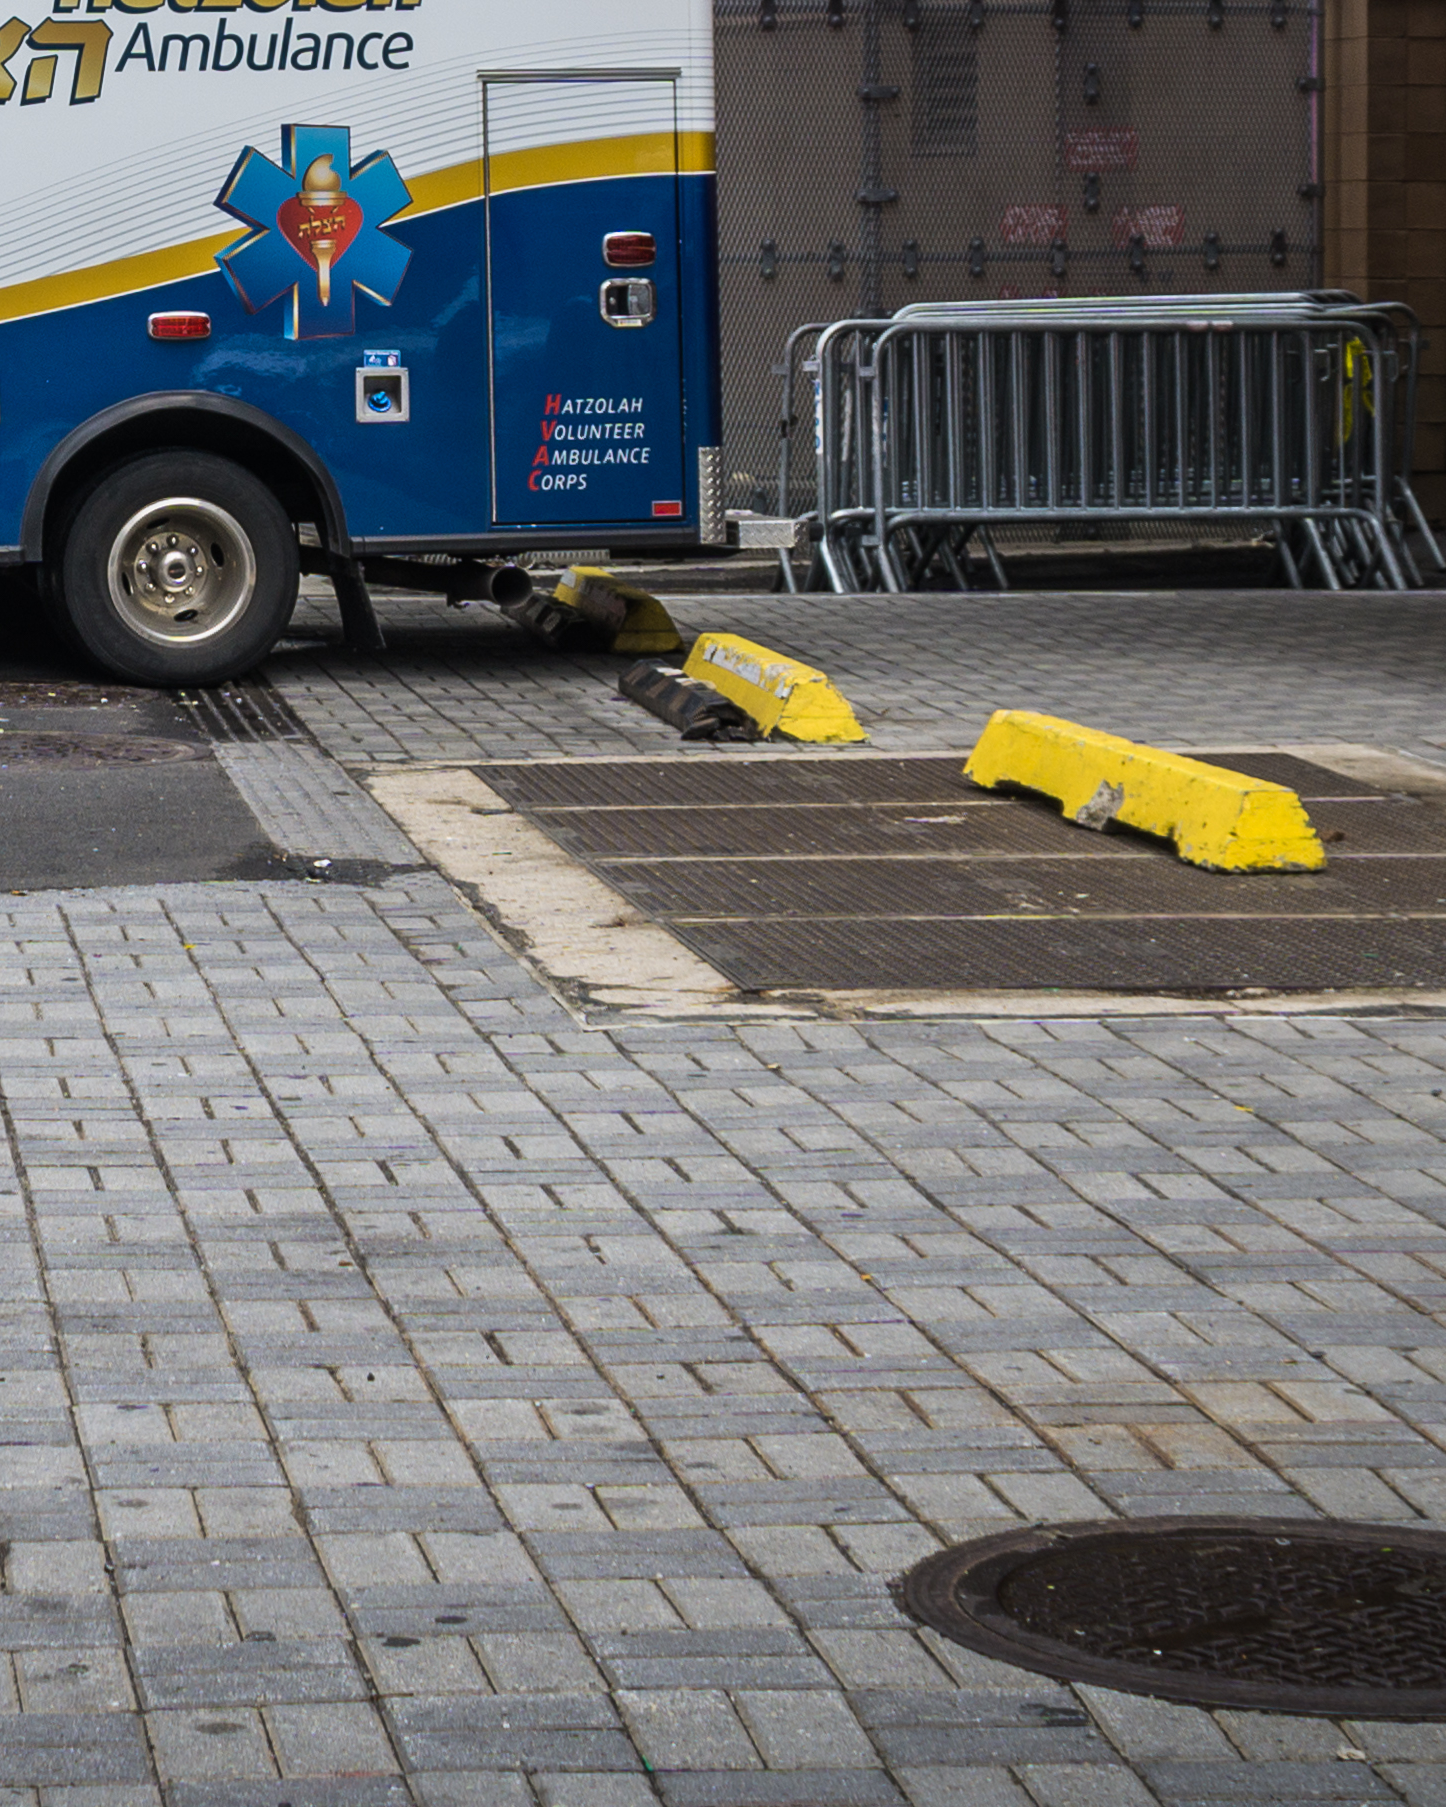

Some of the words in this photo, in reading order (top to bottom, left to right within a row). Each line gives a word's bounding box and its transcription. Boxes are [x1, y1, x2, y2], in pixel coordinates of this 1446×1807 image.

[114, 16, 415, 72] Ambulance
[298, 215, 346, 240] הצלה
[544, 393, 643, 416] HATZOLAH
[540, 420, 645, 441] VOLUNTEER
[532, 445, 651, 466] AMBULANCE
[527, 469, 588, 491] CORPS
